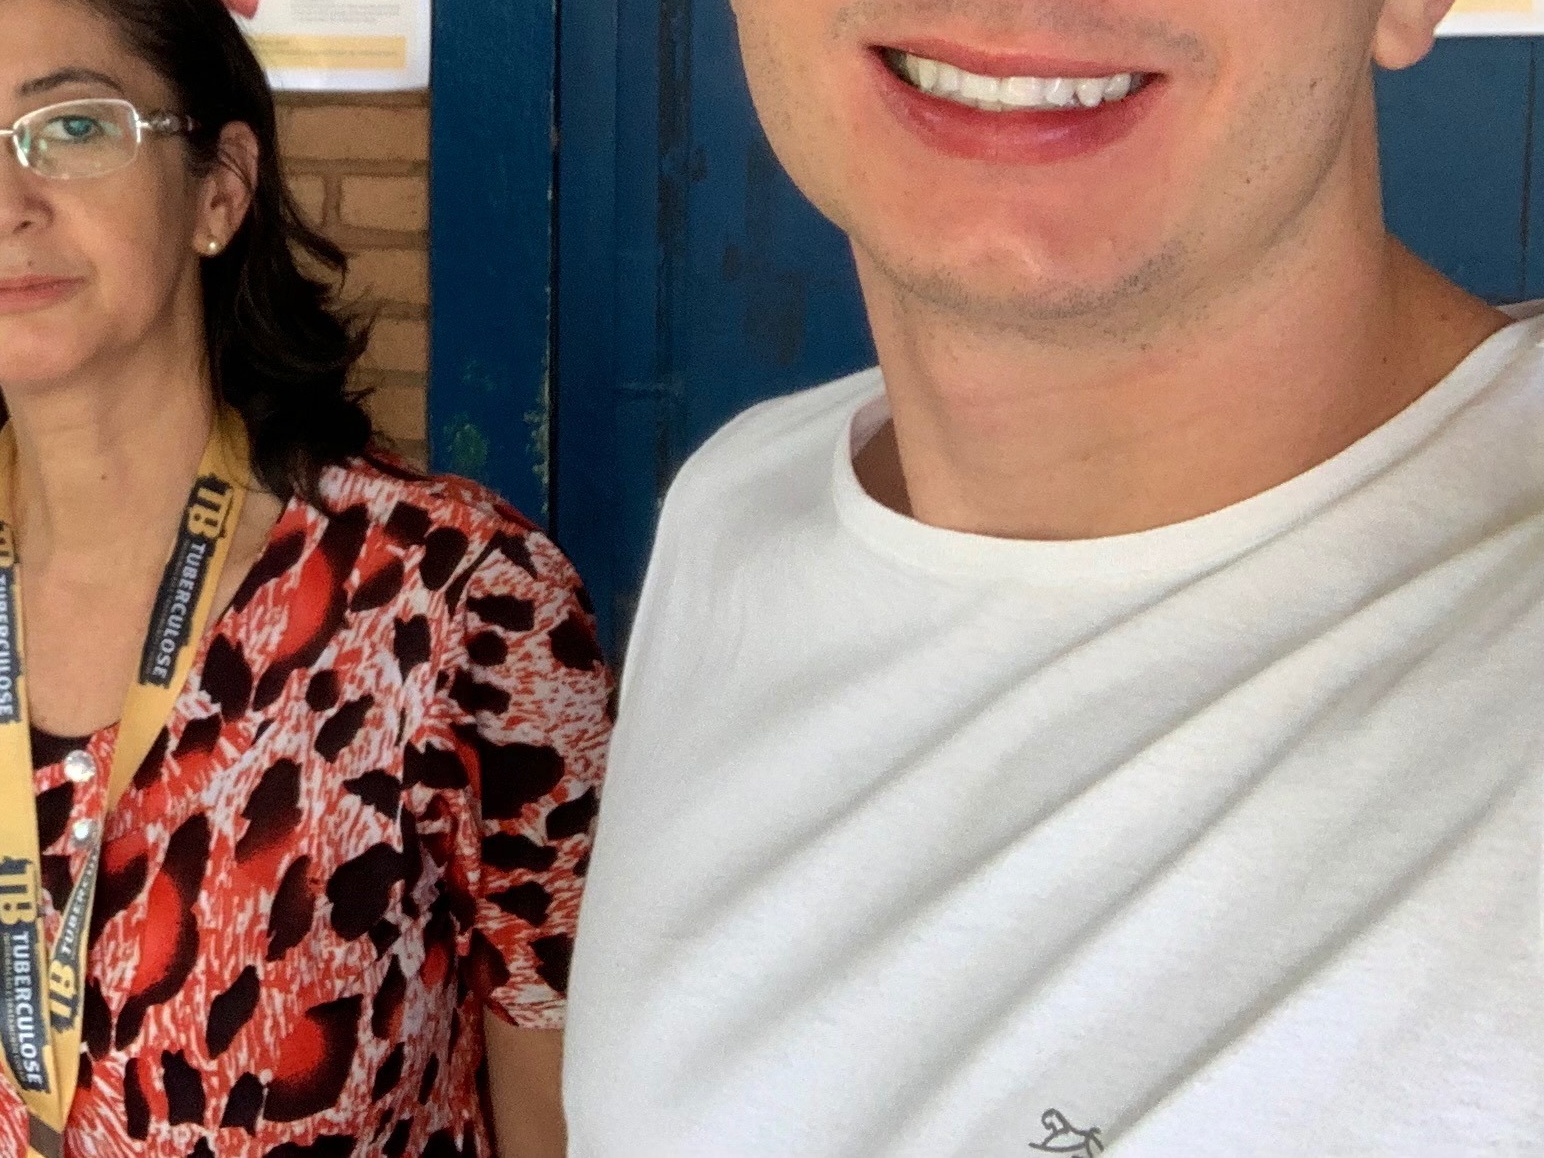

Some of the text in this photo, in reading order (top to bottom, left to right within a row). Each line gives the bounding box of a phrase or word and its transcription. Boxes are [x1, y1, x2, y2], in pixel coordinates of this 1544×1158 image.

[187, 486, 233, 538] TB
[152, 542, 206, 679] TUBERCULOSE
[12, 930, 44, 1086] TUBERCULOSE
